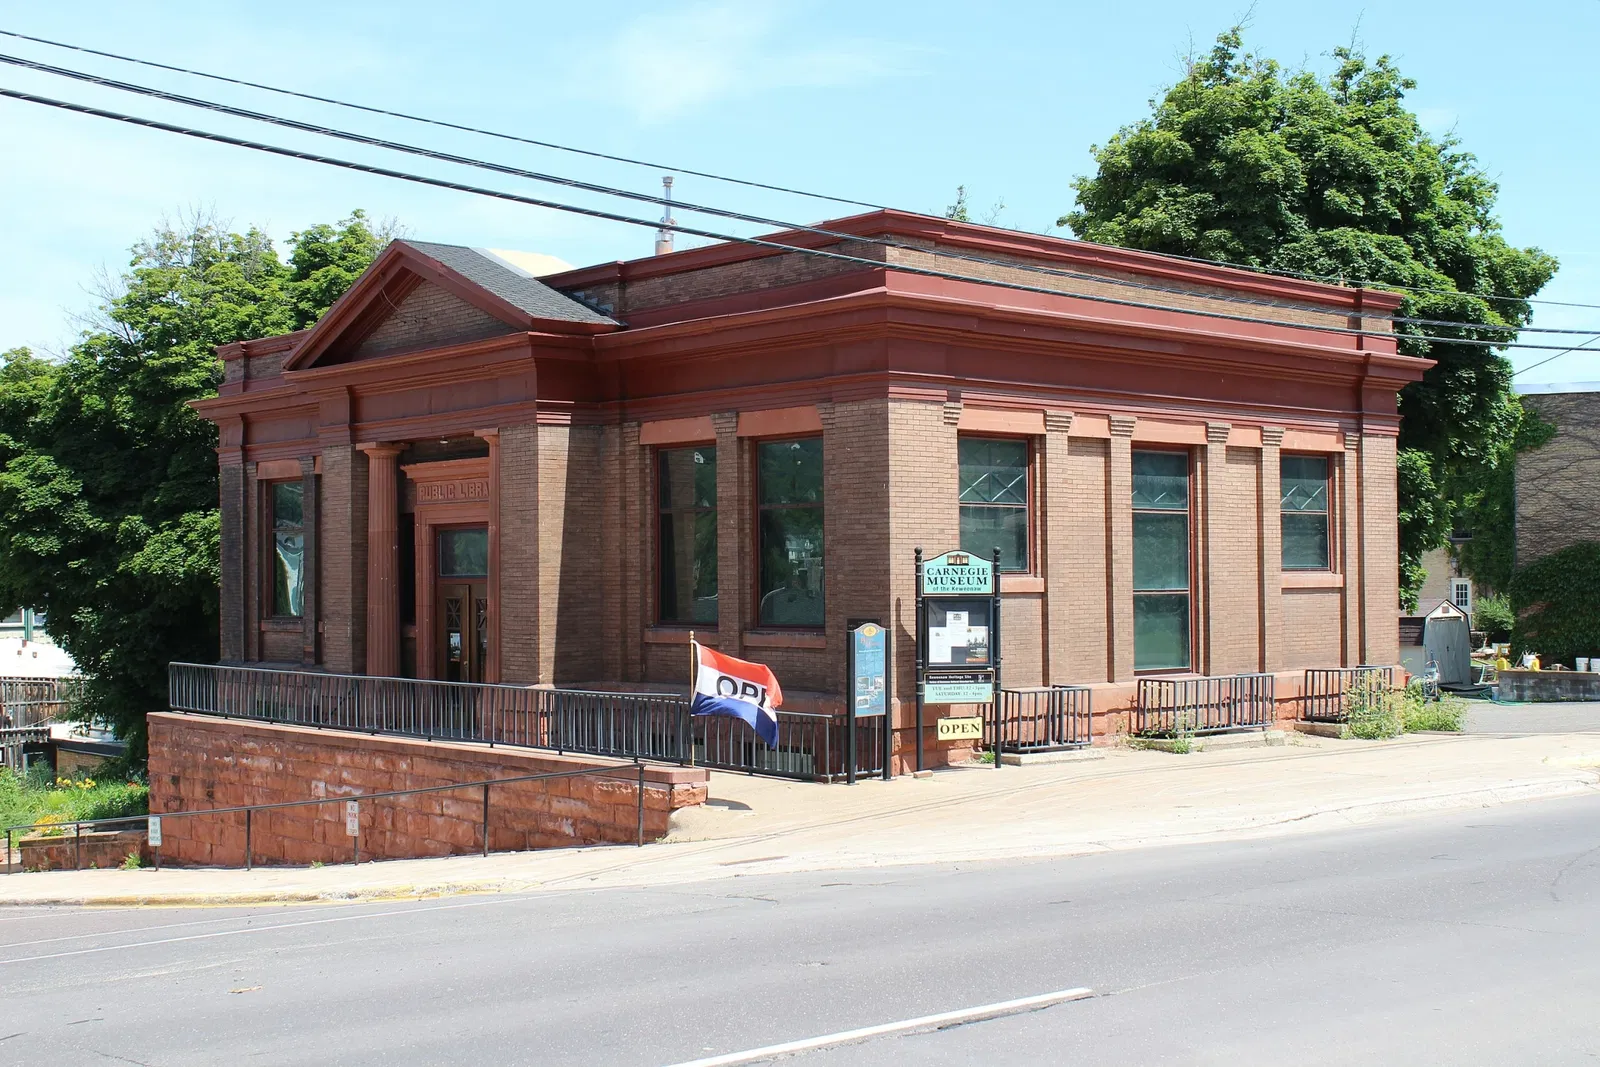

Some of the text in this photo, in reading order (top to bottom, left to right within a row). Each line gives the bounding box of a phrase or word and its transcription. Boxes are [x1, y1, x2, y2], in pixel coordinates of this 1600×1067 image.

[418, 481, 489, 501] PUBLIC LIBRA
[926, 567, 989, 576] CARNEGIE
[926, 576, 988, 586] MUSEUM
[940, 723, 980, 734] OPEN
